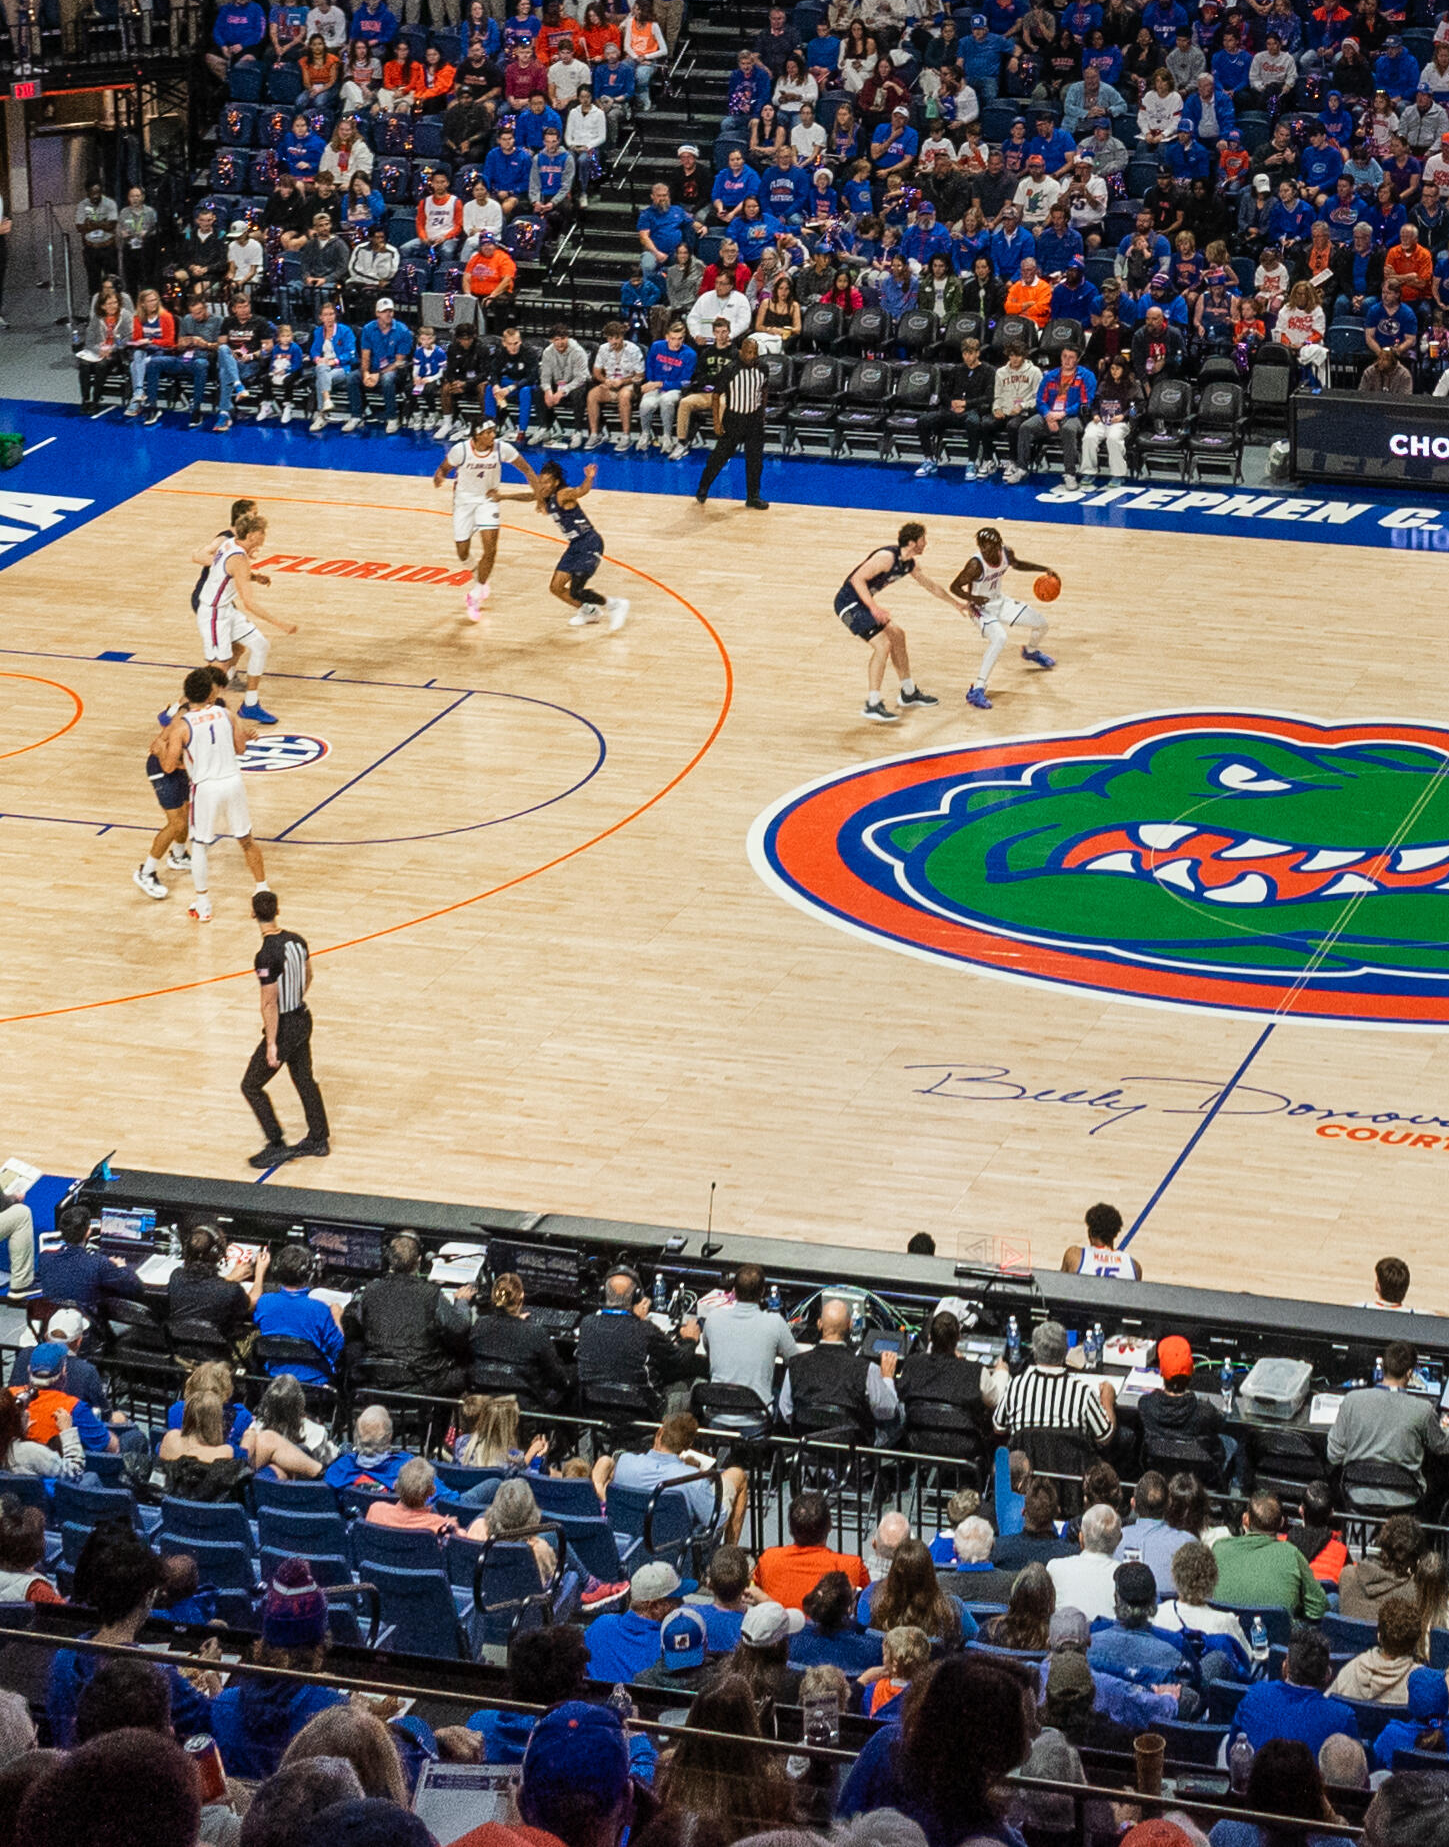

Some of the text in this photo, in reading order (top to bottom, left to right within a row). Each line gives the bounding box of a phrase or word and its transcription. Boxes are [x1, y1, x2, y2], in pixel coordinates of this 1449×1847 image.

[466, 461, 498, 471] FLORIDA
[476, 470, 485, 480] 4
[1035, 486, 1377, 524] STEPHEN
[1377, 507, 1444, 531] C.
[252, 554, 474, 587] FLORIDA
[1093, 1252, 1122, 1264] MARTIN
